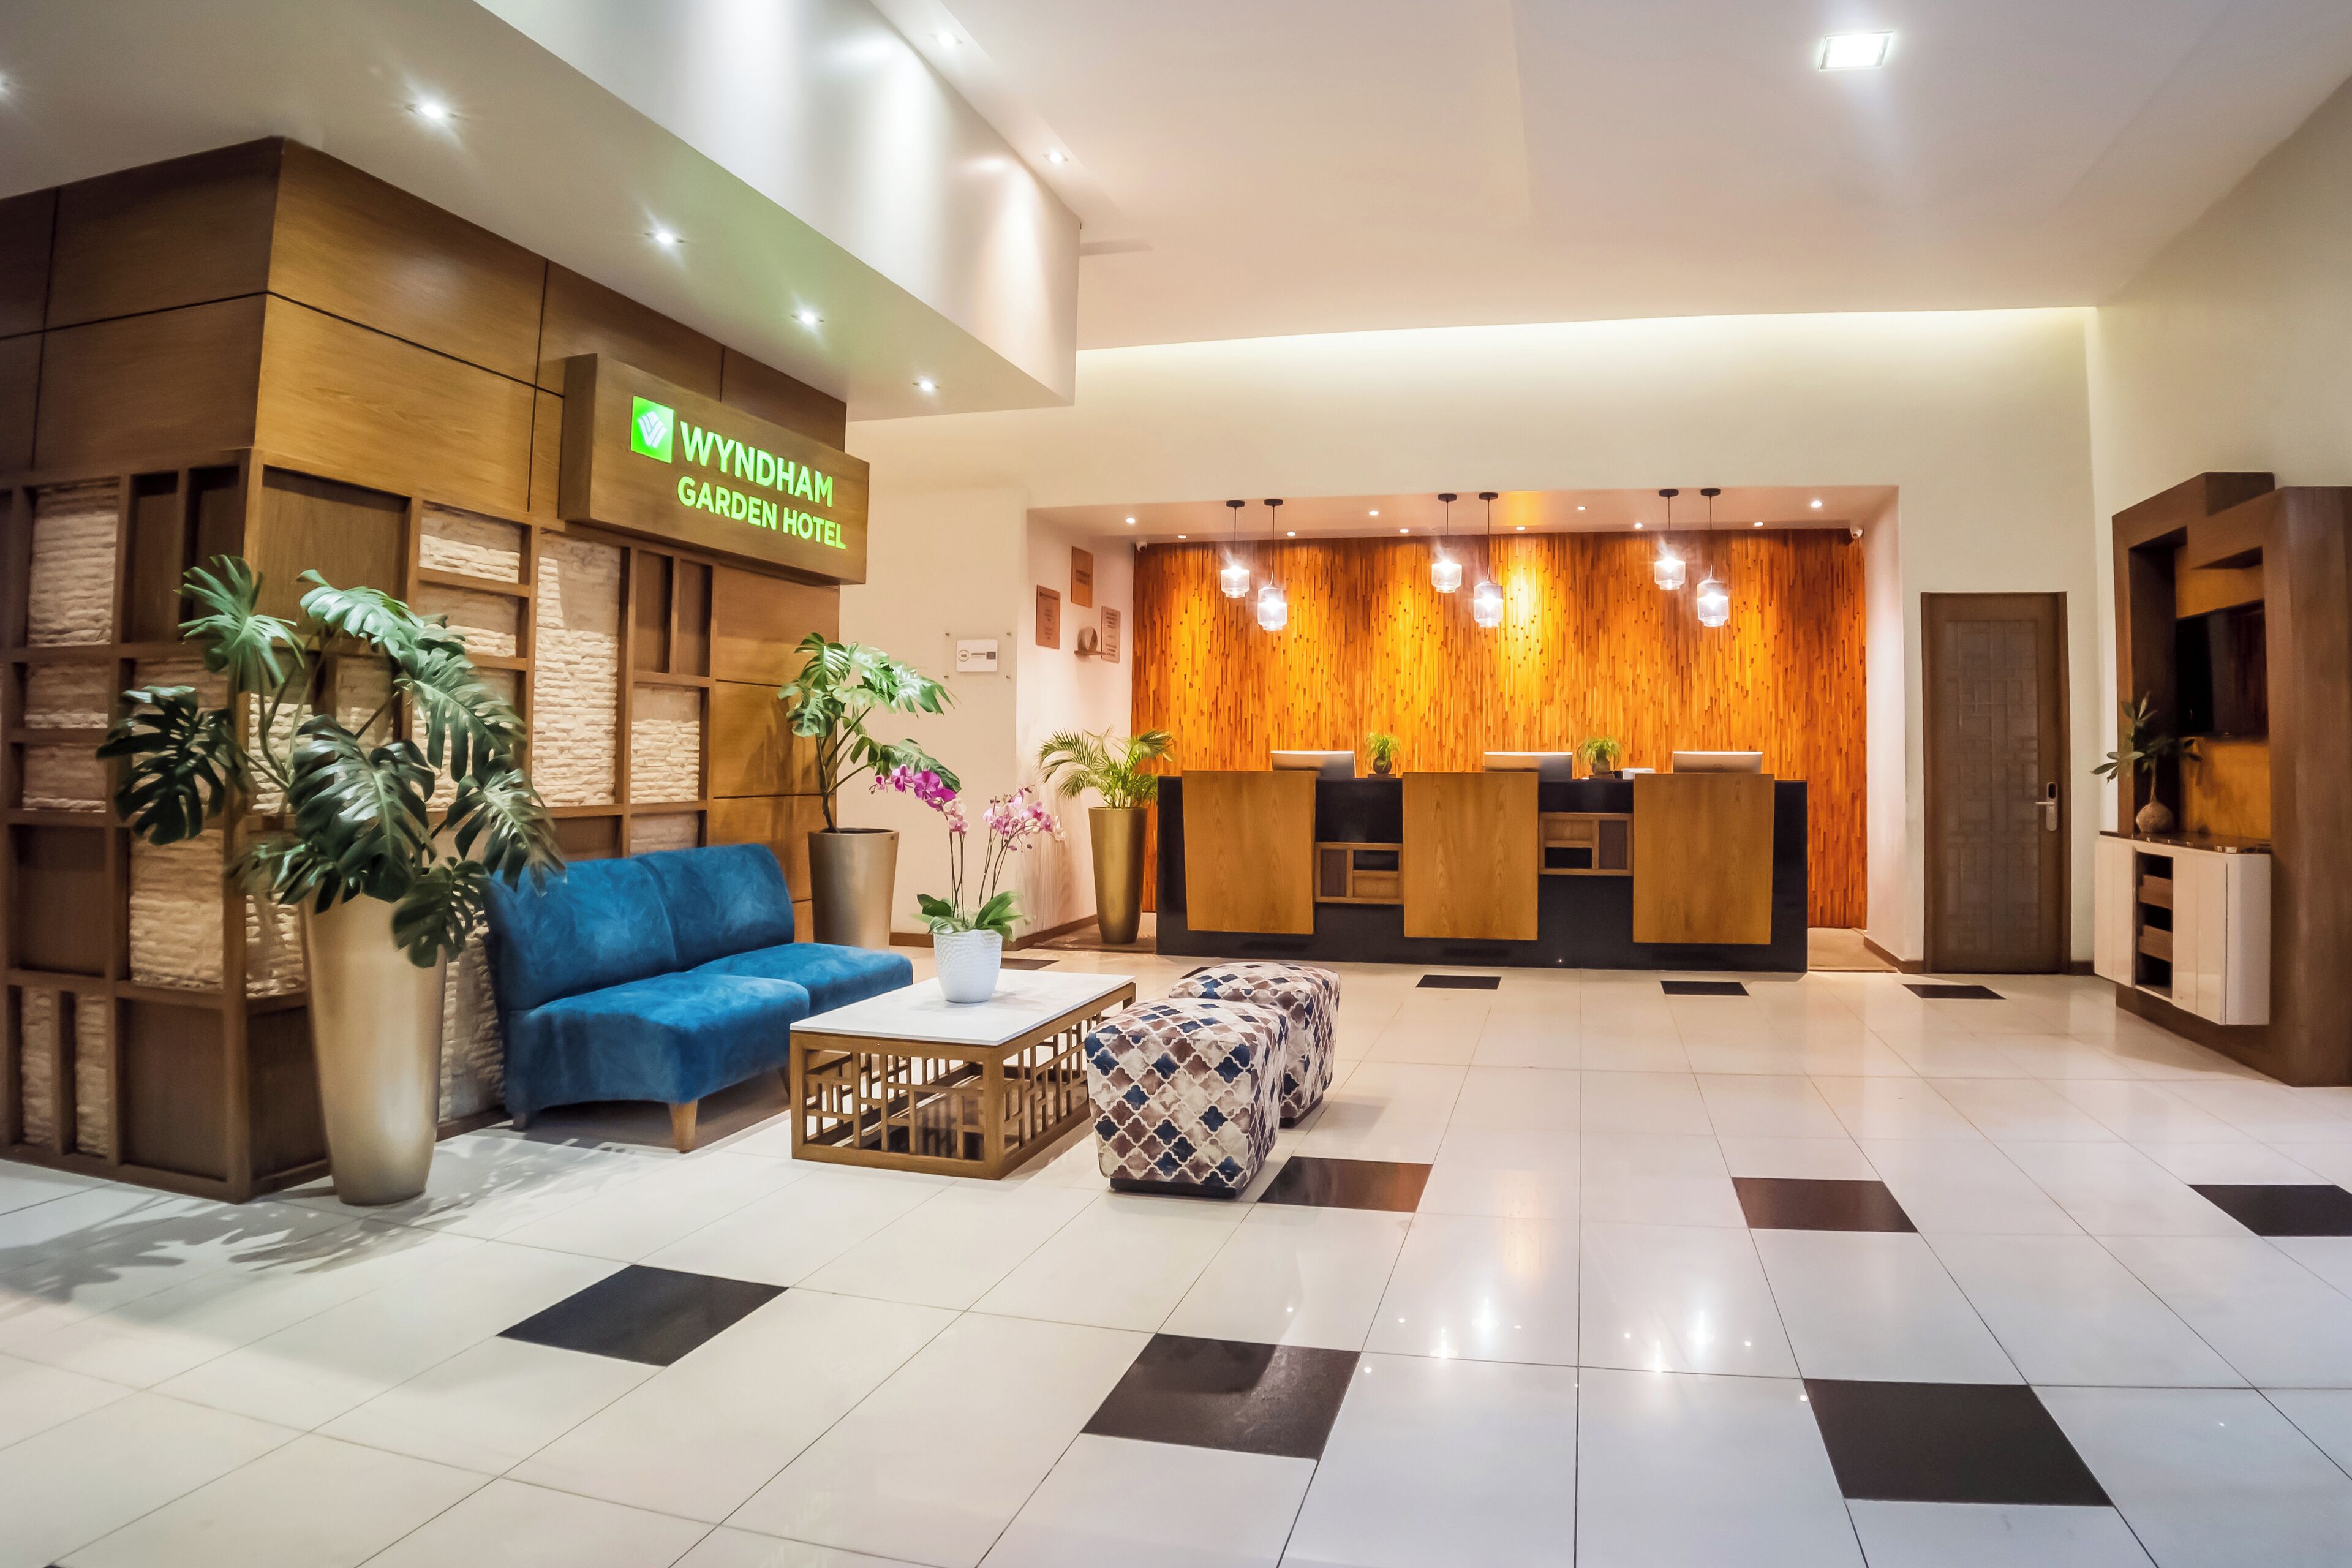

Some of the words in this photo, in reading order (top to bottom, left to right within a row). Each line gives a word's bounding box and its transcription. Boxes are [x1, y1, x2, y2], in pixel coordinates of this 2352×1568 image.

[680, 421, 833, 507] WYNDHAM
[677, 476, 777, 530] GARDEN
[783, 507, 846, 549] HOTEL
